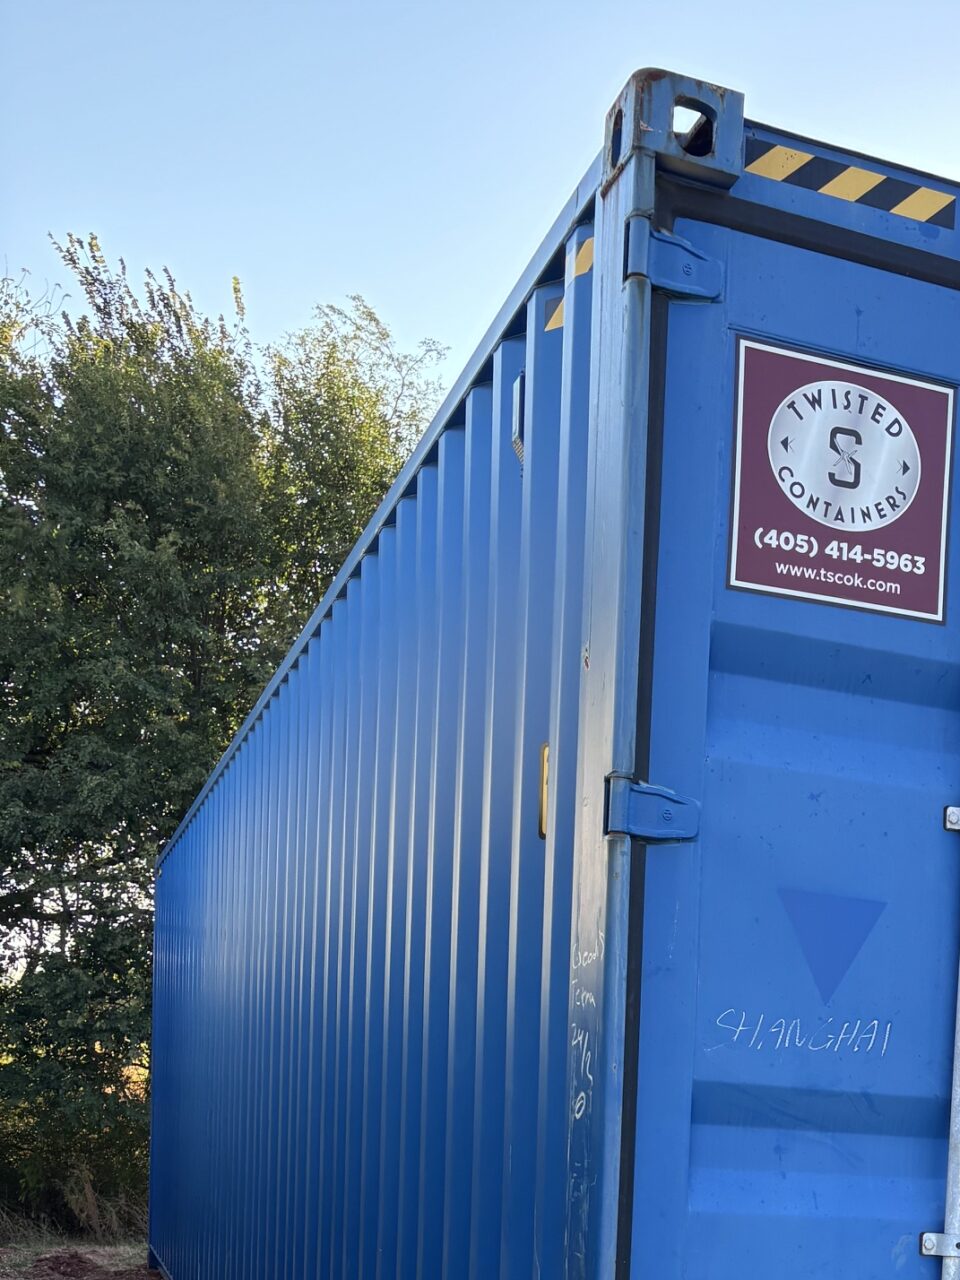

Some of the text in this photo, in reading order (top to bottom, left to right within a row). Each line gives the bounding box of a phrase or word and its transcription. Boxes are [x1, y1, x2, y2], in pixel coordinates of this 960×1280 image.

[787, 389, 903, 437] TWISTED
[778, 466, 907, 523] CONTAINERS
[754, 527, 926, 575] (405) 414-5963
[775, 562, 901, 595] www.tscok.com
